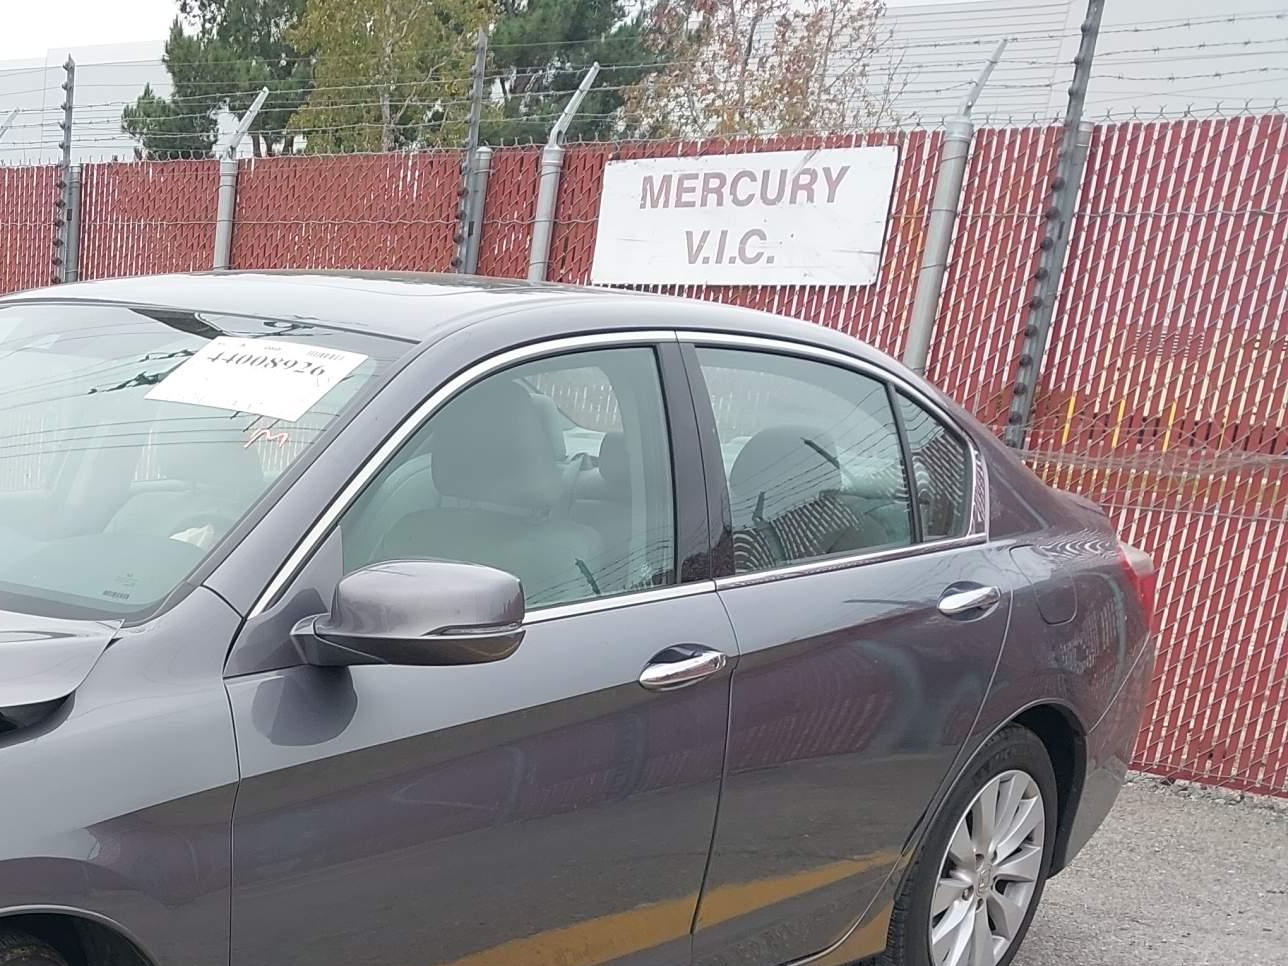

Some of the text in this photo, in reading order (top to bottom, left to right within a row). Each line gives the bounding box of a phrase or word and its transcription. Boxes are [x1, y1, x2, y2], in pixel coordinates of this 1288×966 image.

[639, 165, 851, 209] MERCURY
[685, 229, 775, 265] V.I.C.
[207, 351, 326, 376] 44008926
